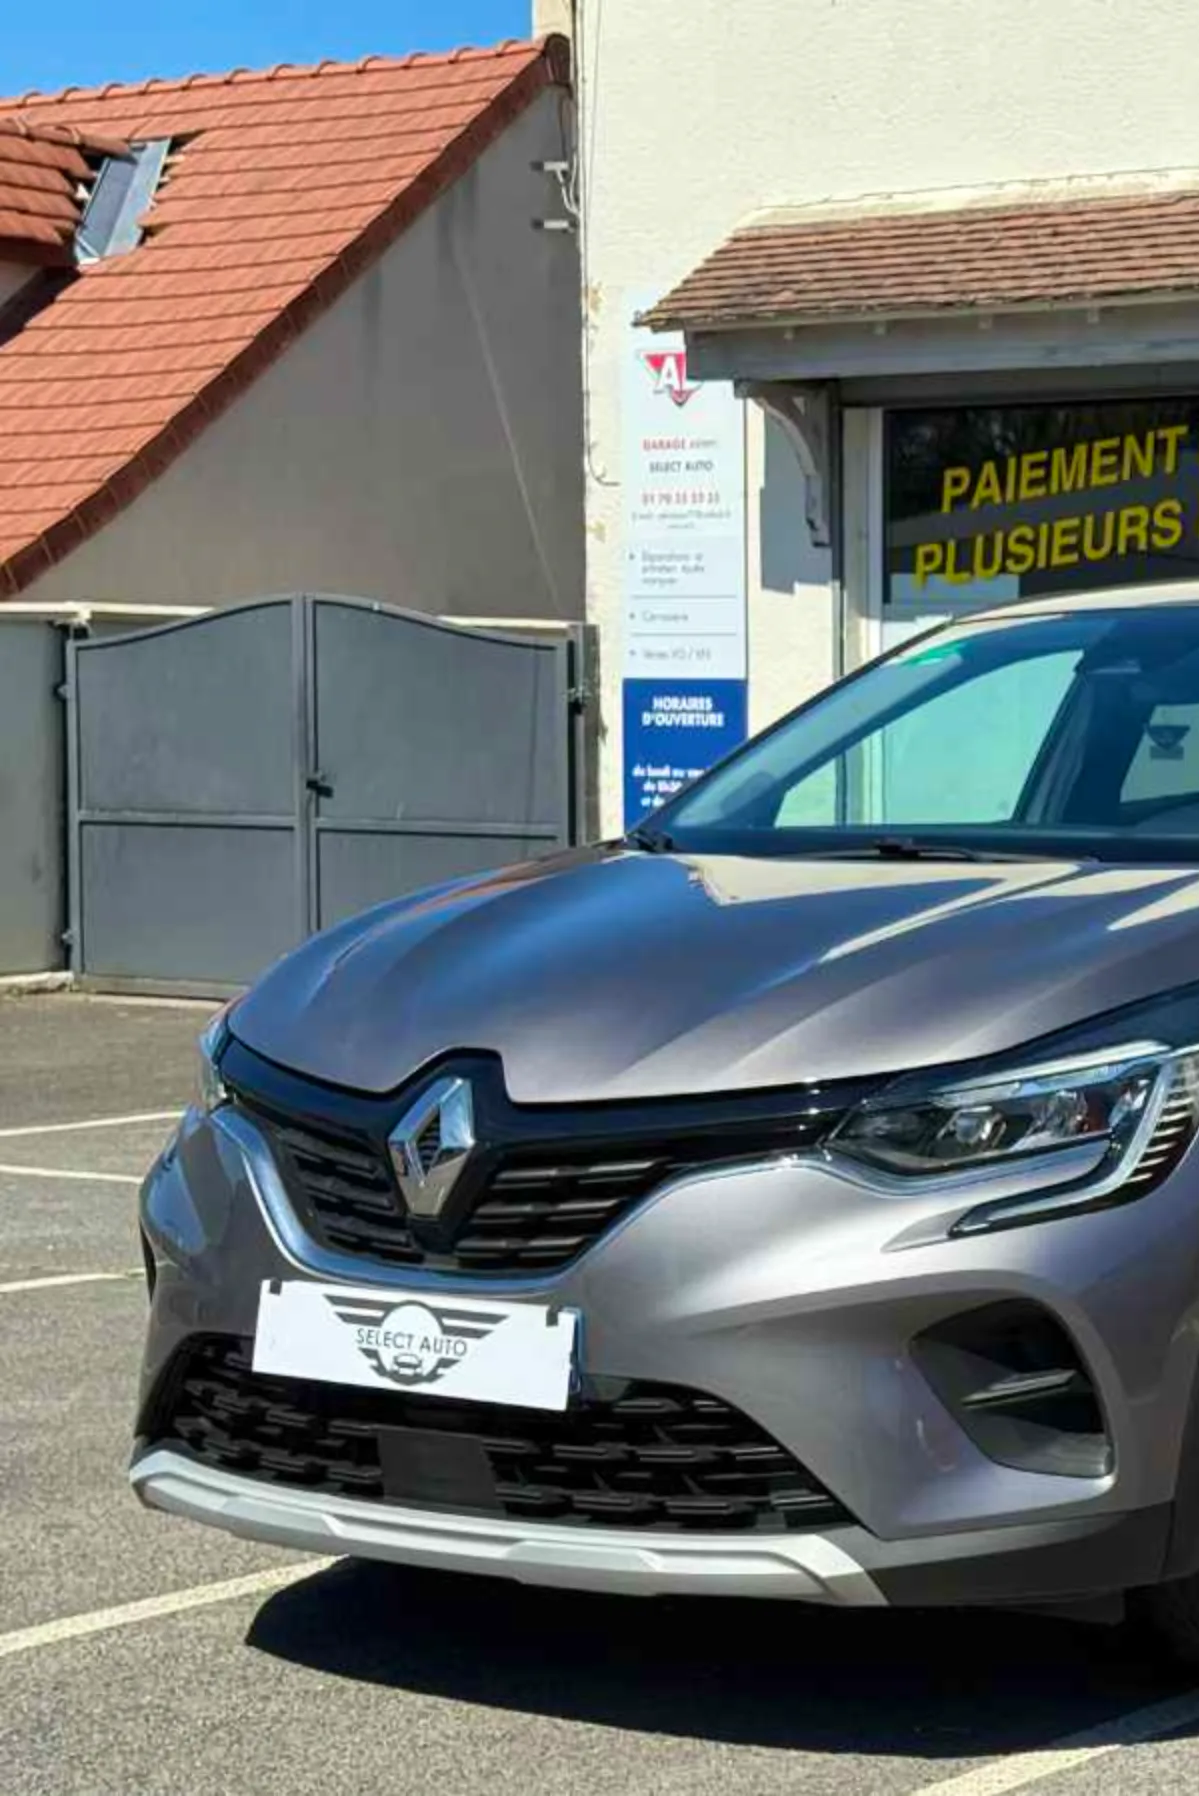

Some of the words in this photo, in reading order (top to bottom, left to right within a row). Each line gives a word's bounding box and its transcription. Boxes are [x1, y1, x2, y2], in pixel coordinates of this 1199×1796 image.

[643, 438, 685, 451] GARAGE
[649, 460, 682, 473] SELECT
[685, 459, 714, 472] AUTO
[941, 425, 1189, 513] PAIEMENT
[914, 499, 1183, 589] PLUSIEURS
[653, 696, 713, 711] HORAIRES
[642, 712, 725, 728] D'OUVERTURE
[356, 1328, 414, 1350] SELECT
[419, 1336, 468, 1357] AUTO
